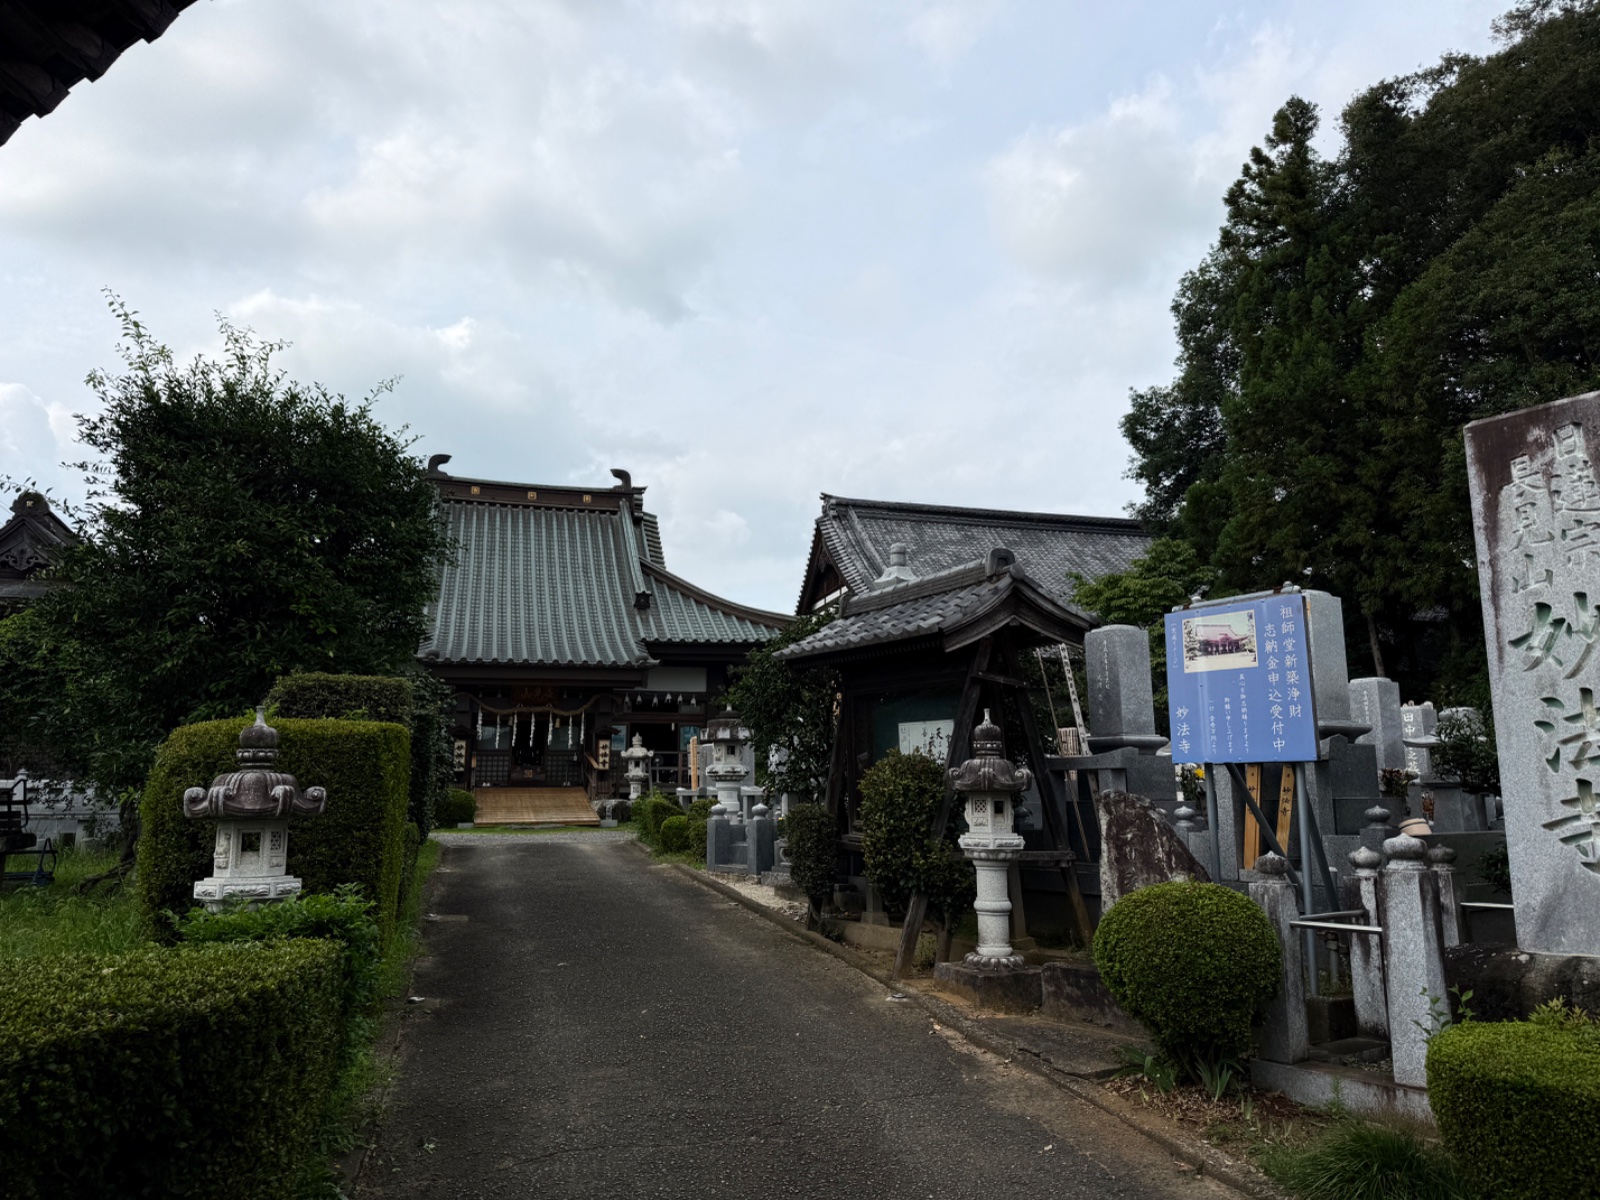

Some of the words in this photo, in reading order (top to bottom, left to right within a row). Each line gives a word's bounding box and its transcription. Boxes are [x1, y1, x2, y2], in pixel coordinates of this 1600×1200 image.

[1510, 453, 1555, 595] 長見山
[1264, 623, 1286, 752] 志納金申込受付中
[1280, 605, 1302, 718] 祖師堂新築浄財
[1175, 705, 1191, 754] 妙法寺
